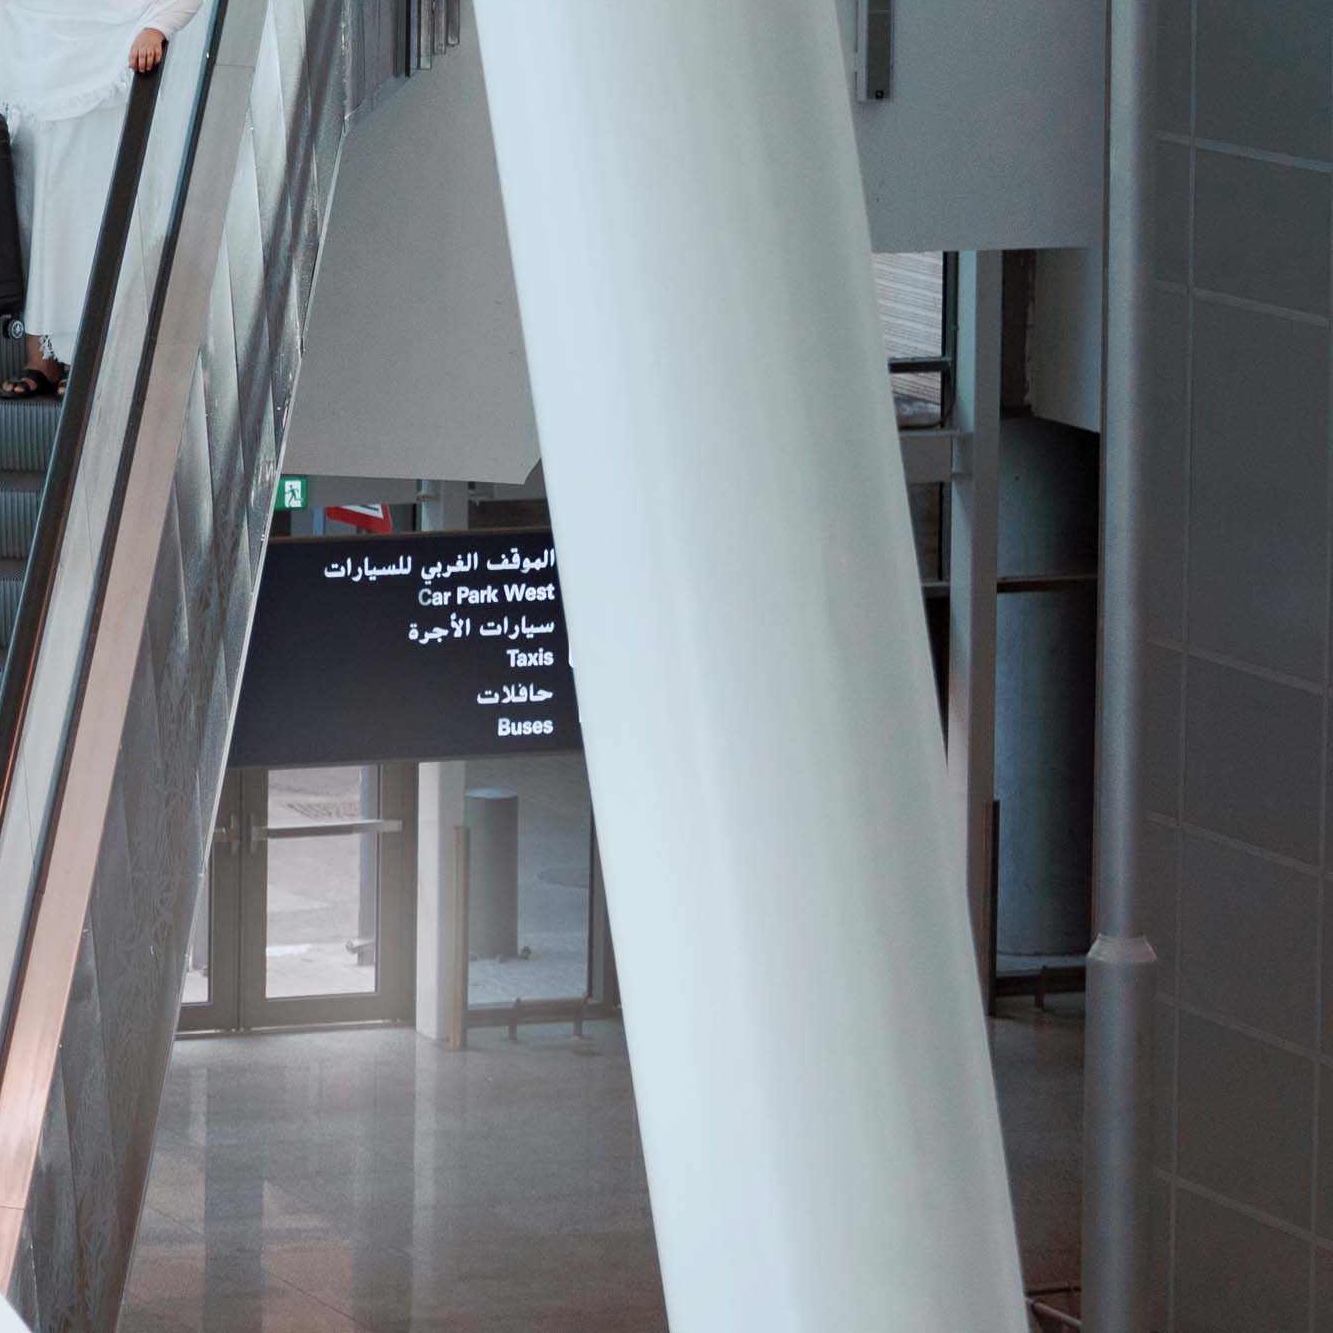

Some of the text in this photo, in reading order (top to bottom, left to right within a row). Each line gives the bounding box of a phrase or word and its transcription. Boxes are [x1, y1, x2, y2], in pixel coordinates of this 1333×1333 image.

[324, 548, 555, 585] الموقف الغربي للسيارات
[418, 583, 555, 607] Car Park West
[409, 613, 554, 644] سيارات الأجرة
[506, 648, 554, 667] Taxis
[477, 684, 553, 704] حافلات
[498, 718, 553, 736] Buses
